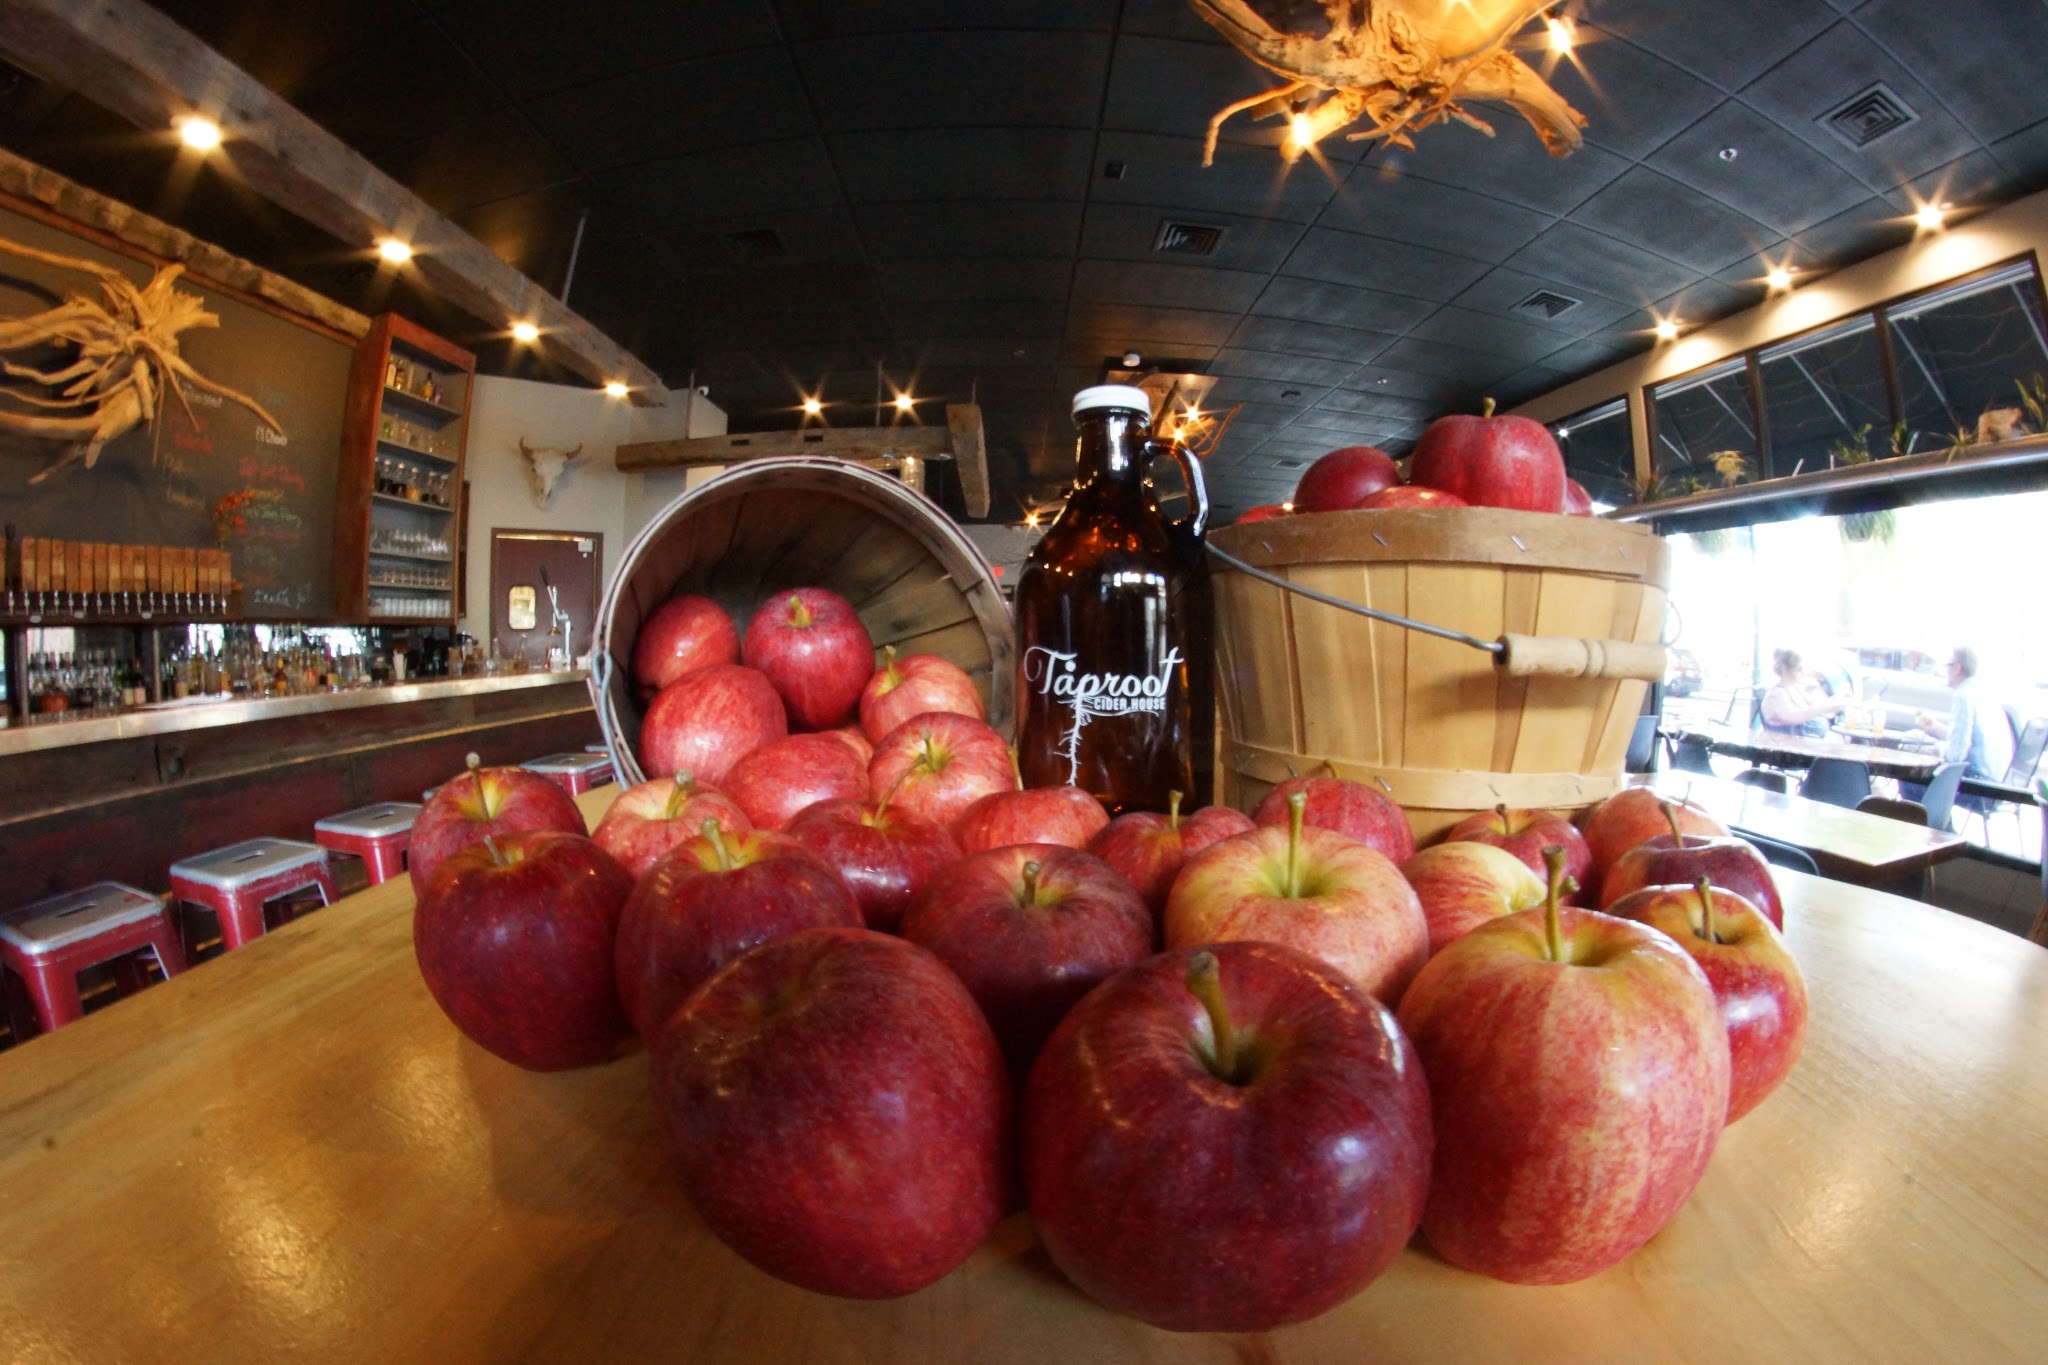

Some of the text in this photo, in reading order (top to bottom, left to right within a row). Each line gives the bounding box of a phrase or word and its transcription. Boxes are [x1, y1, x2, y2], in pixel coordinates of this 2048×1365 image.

[1024, 646, 1184, 699] Taproot
[1094, 697, 1166, 711] CIDER HOUSE
